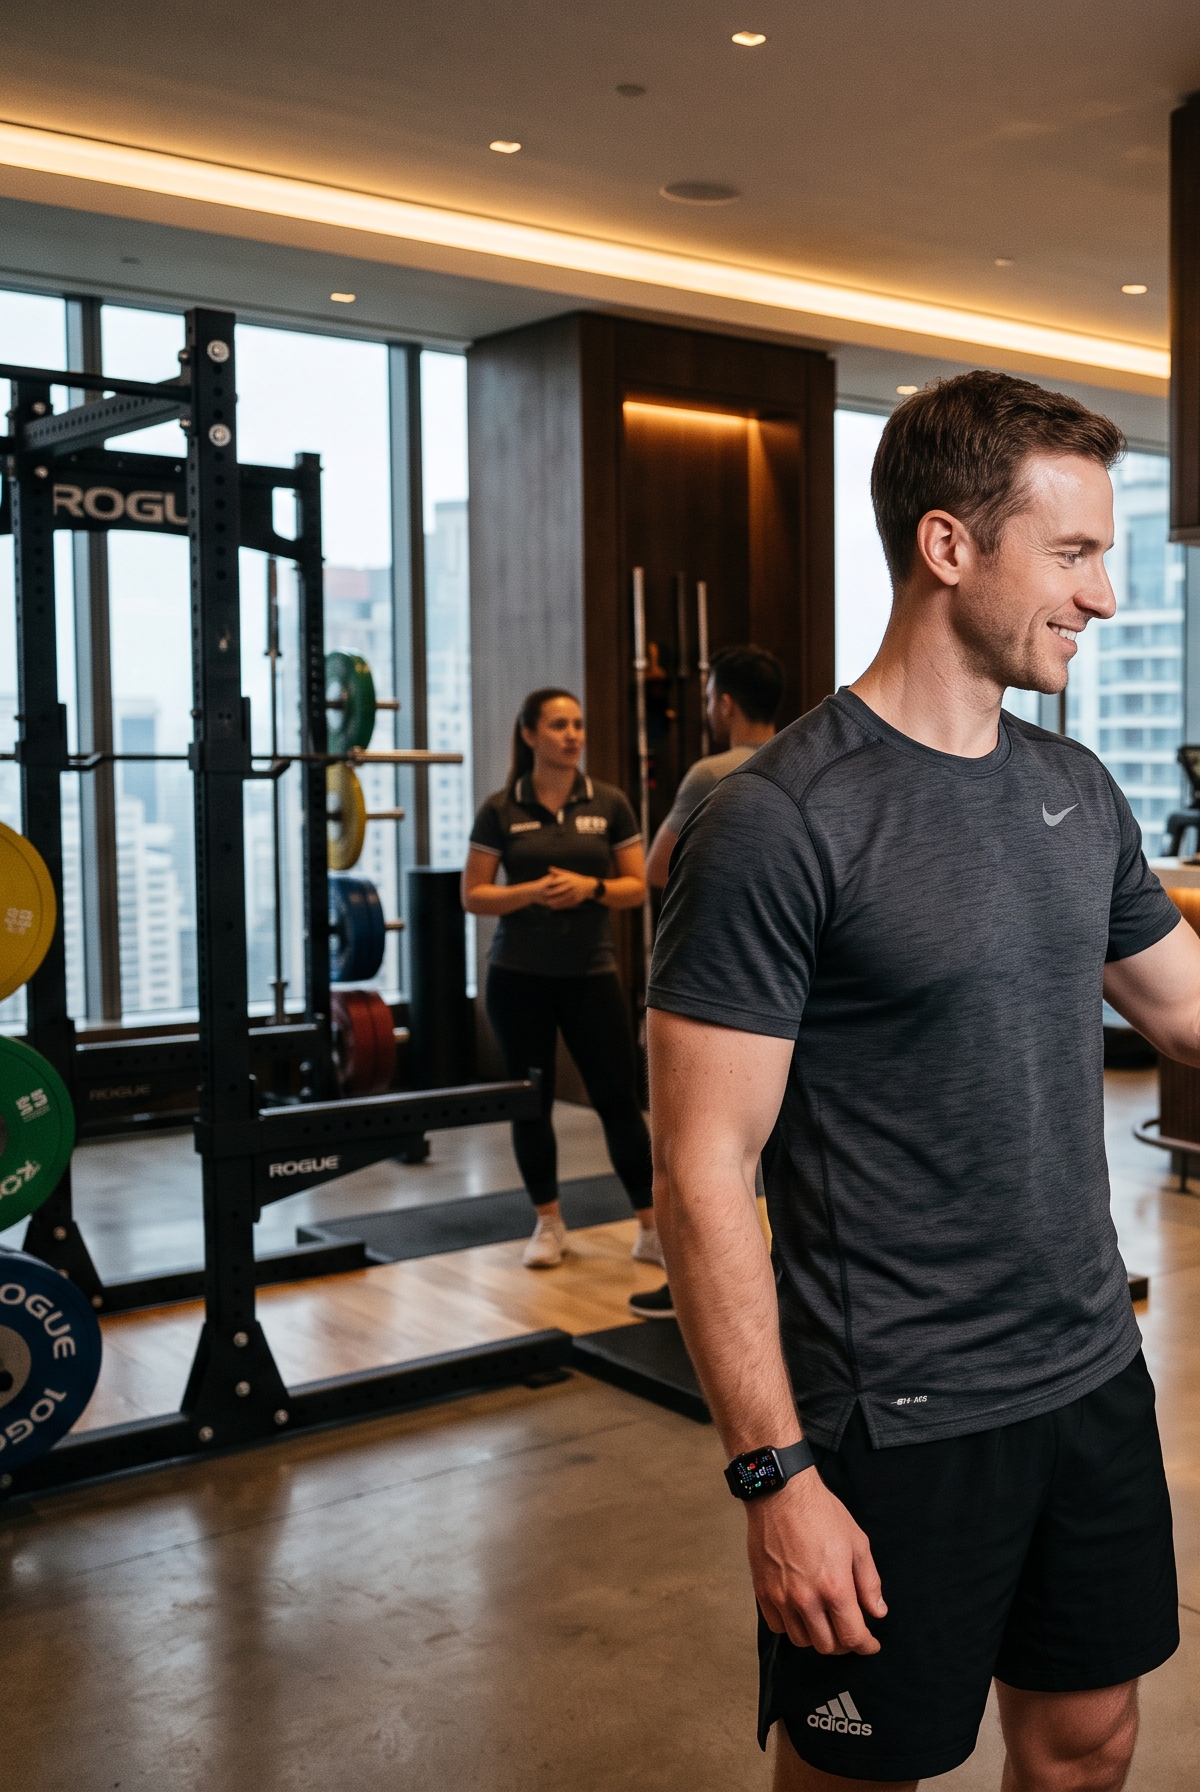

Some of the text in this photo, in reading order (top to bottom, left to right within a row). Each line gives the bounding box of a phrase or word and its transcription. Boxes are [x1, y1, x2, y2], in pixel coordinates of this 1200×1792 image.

[53, 483, 188, 527] ROGU
[269, 1155, 341, 1179] ROGUE
[0, 1283, 76, 1360] OGUE
[807, 1713, 872, 1737] adidas
